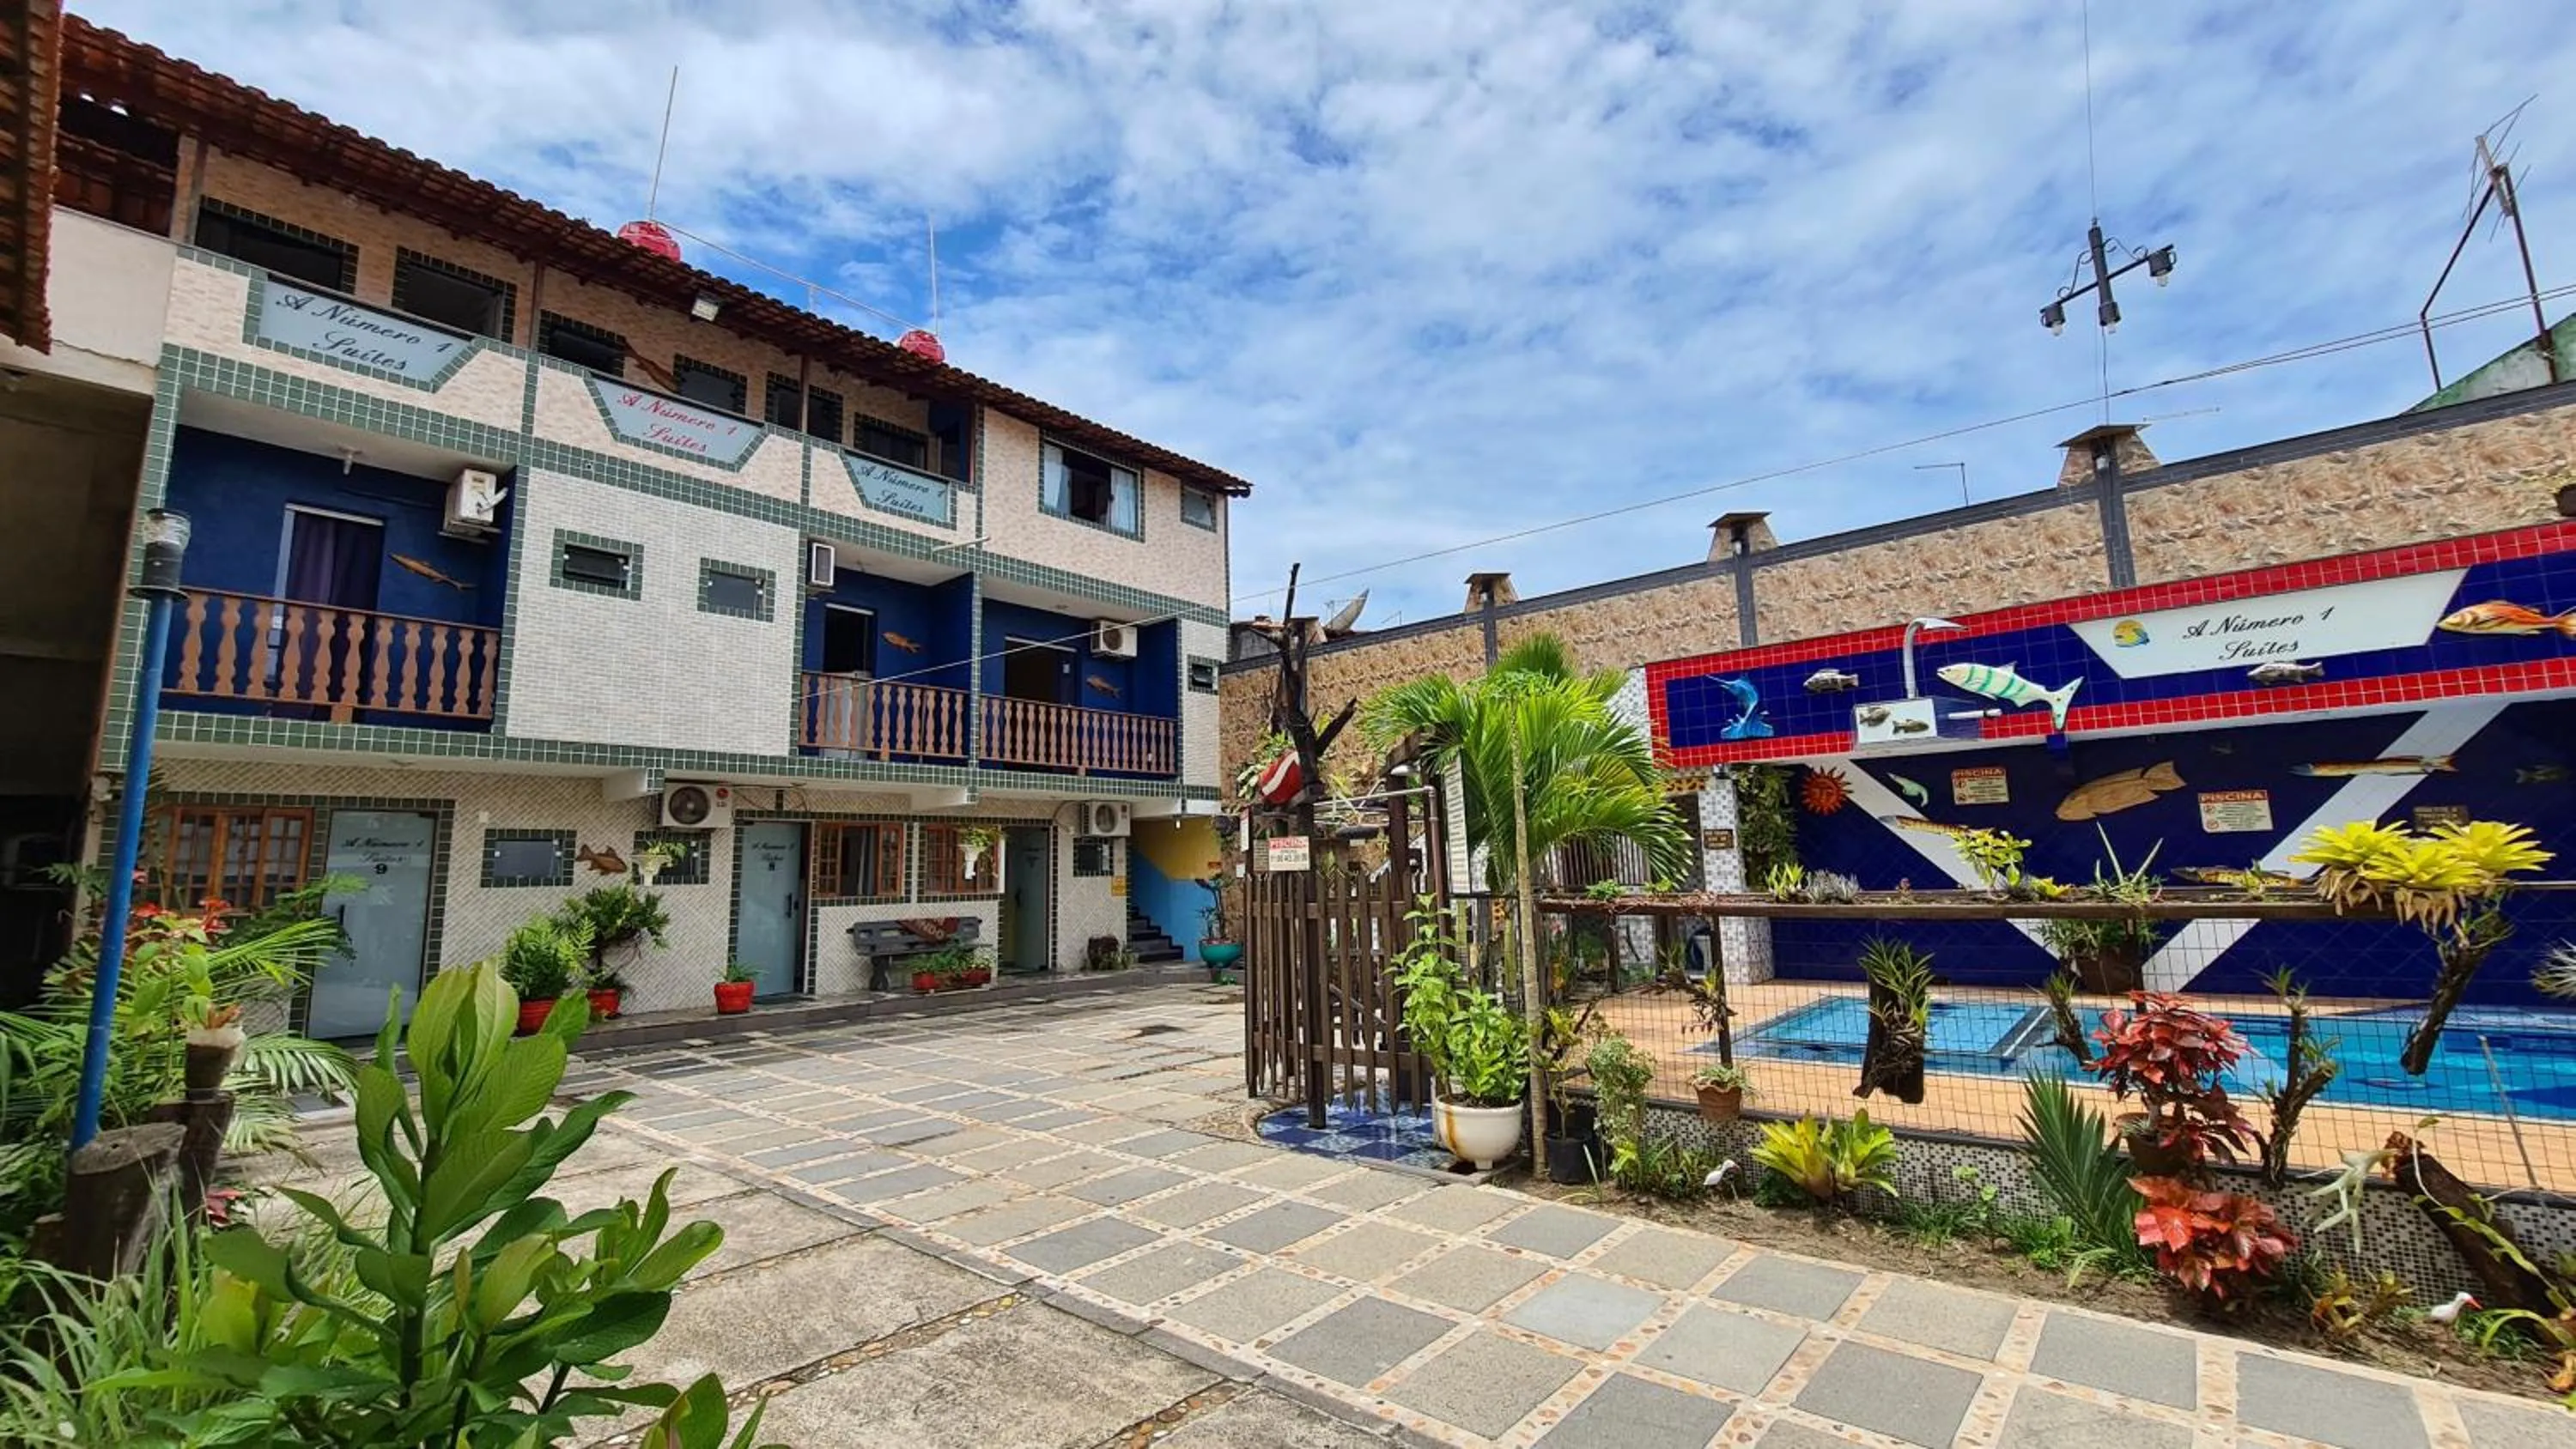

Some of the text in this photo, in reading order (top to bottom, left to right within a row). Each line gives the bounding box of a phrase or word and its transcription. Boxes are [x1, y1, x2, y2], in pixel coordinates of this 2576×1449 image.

[276, 294, 453, 353] A Número 1
[313, 330, 407, 371] Suites
[617, 392, 738, 435] A Número 1
[643, 422, 708, 452] Suites
[857, 464, 877, 477] A
[875, 489, 924, 512] Suites
[2182, 605, 2336, 639] A Número 1
[2218, 640, 2300, 660] Suites
[2200, 791, 2265, 803] PISCINA
